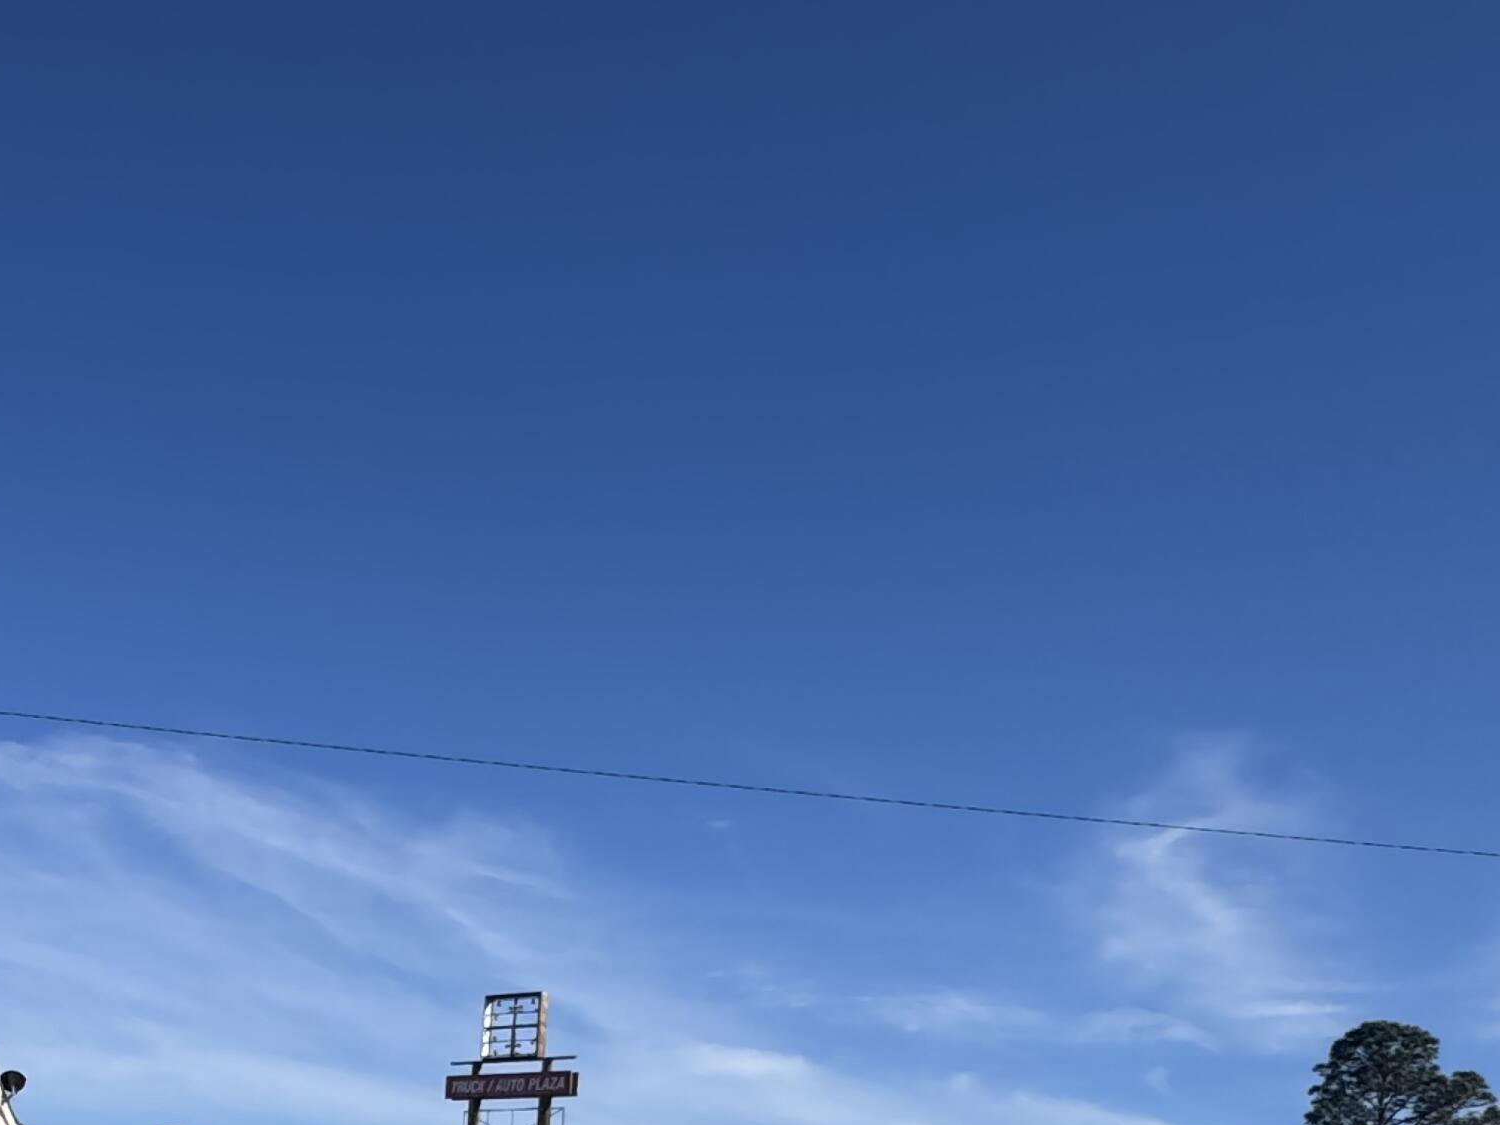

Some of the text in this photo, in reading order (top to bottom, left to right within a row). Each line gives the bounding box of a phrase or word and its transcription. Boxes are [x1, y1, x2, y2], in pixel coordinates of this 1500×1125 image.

[451, 1080, 485, 1093] TRUCK
[495, 1078, 525, 1092] AUTO
[528, 1076, 565, 1091] PLAZA
